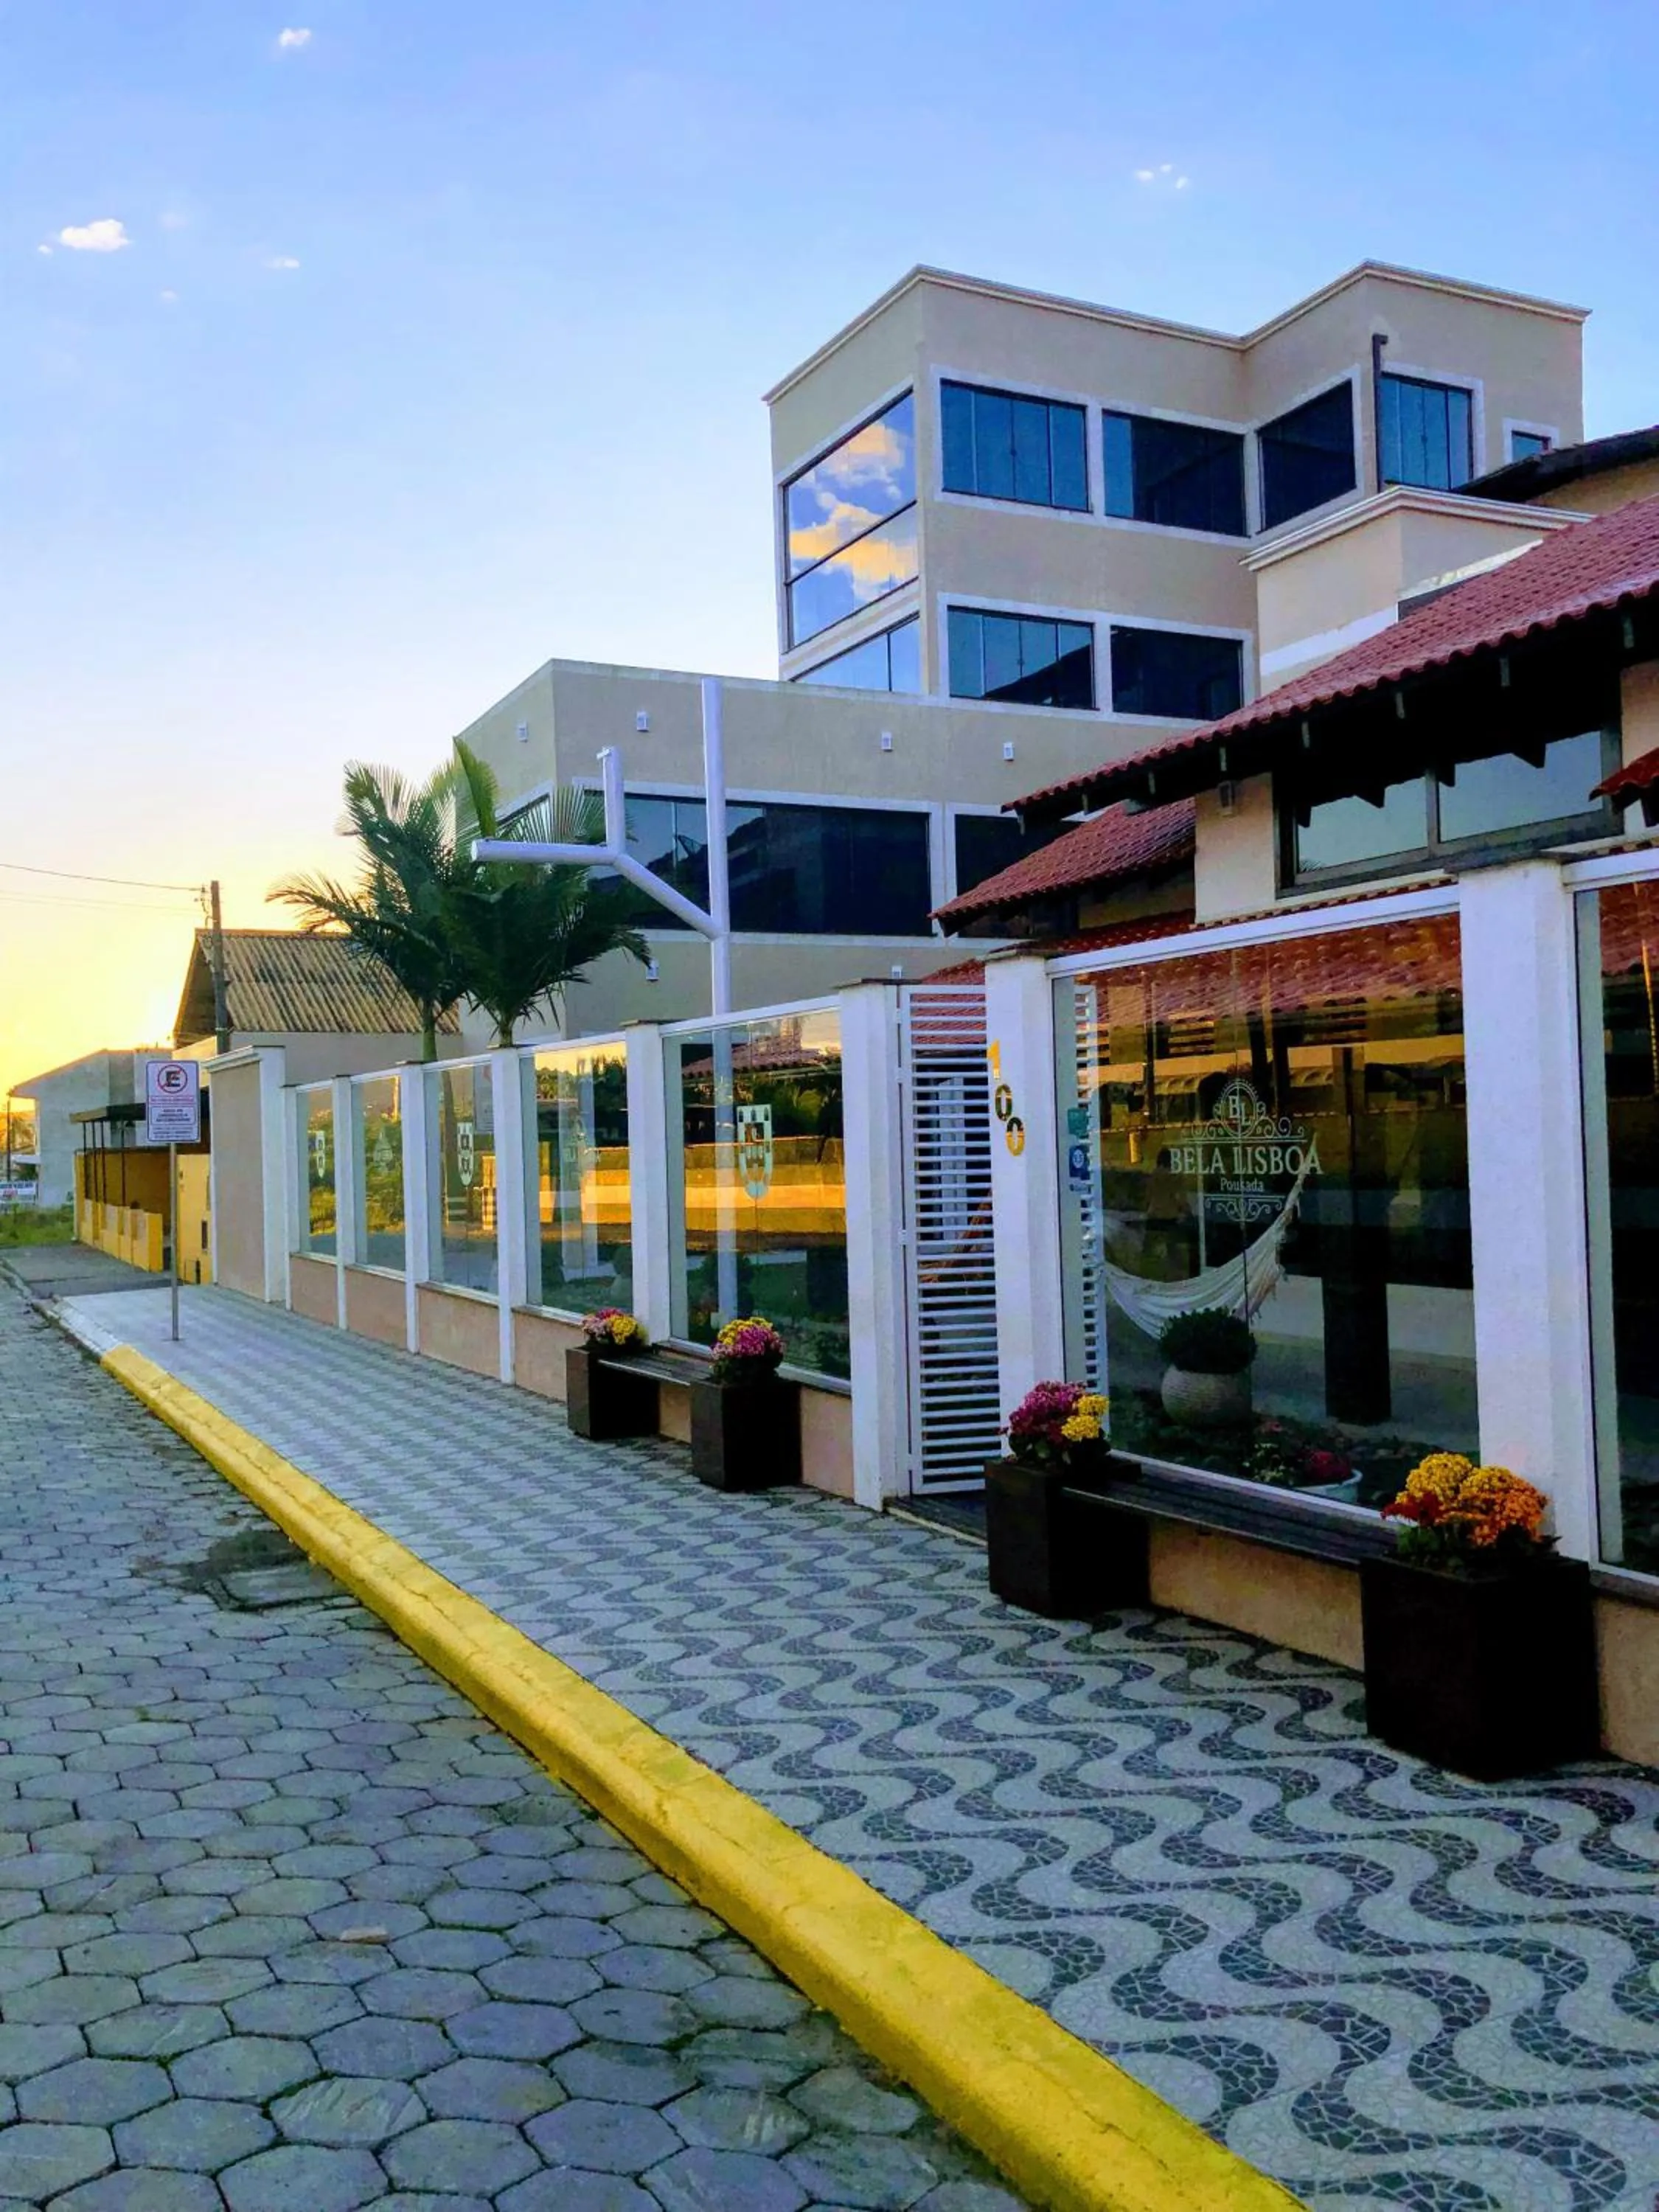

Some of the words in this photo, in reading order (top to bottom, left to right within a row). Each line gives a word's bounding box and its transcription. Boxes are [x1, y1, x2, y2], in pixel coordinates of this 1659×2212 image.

[166, 1071, 180, 1087] E
[987, 1038, 1025, 1157] 100
[1169, 1147, 1225, 1175] BELA
[1232, 1146, 1324, 1175] LISBOA
[1220, 1177, 1265, 1192] Pousada
